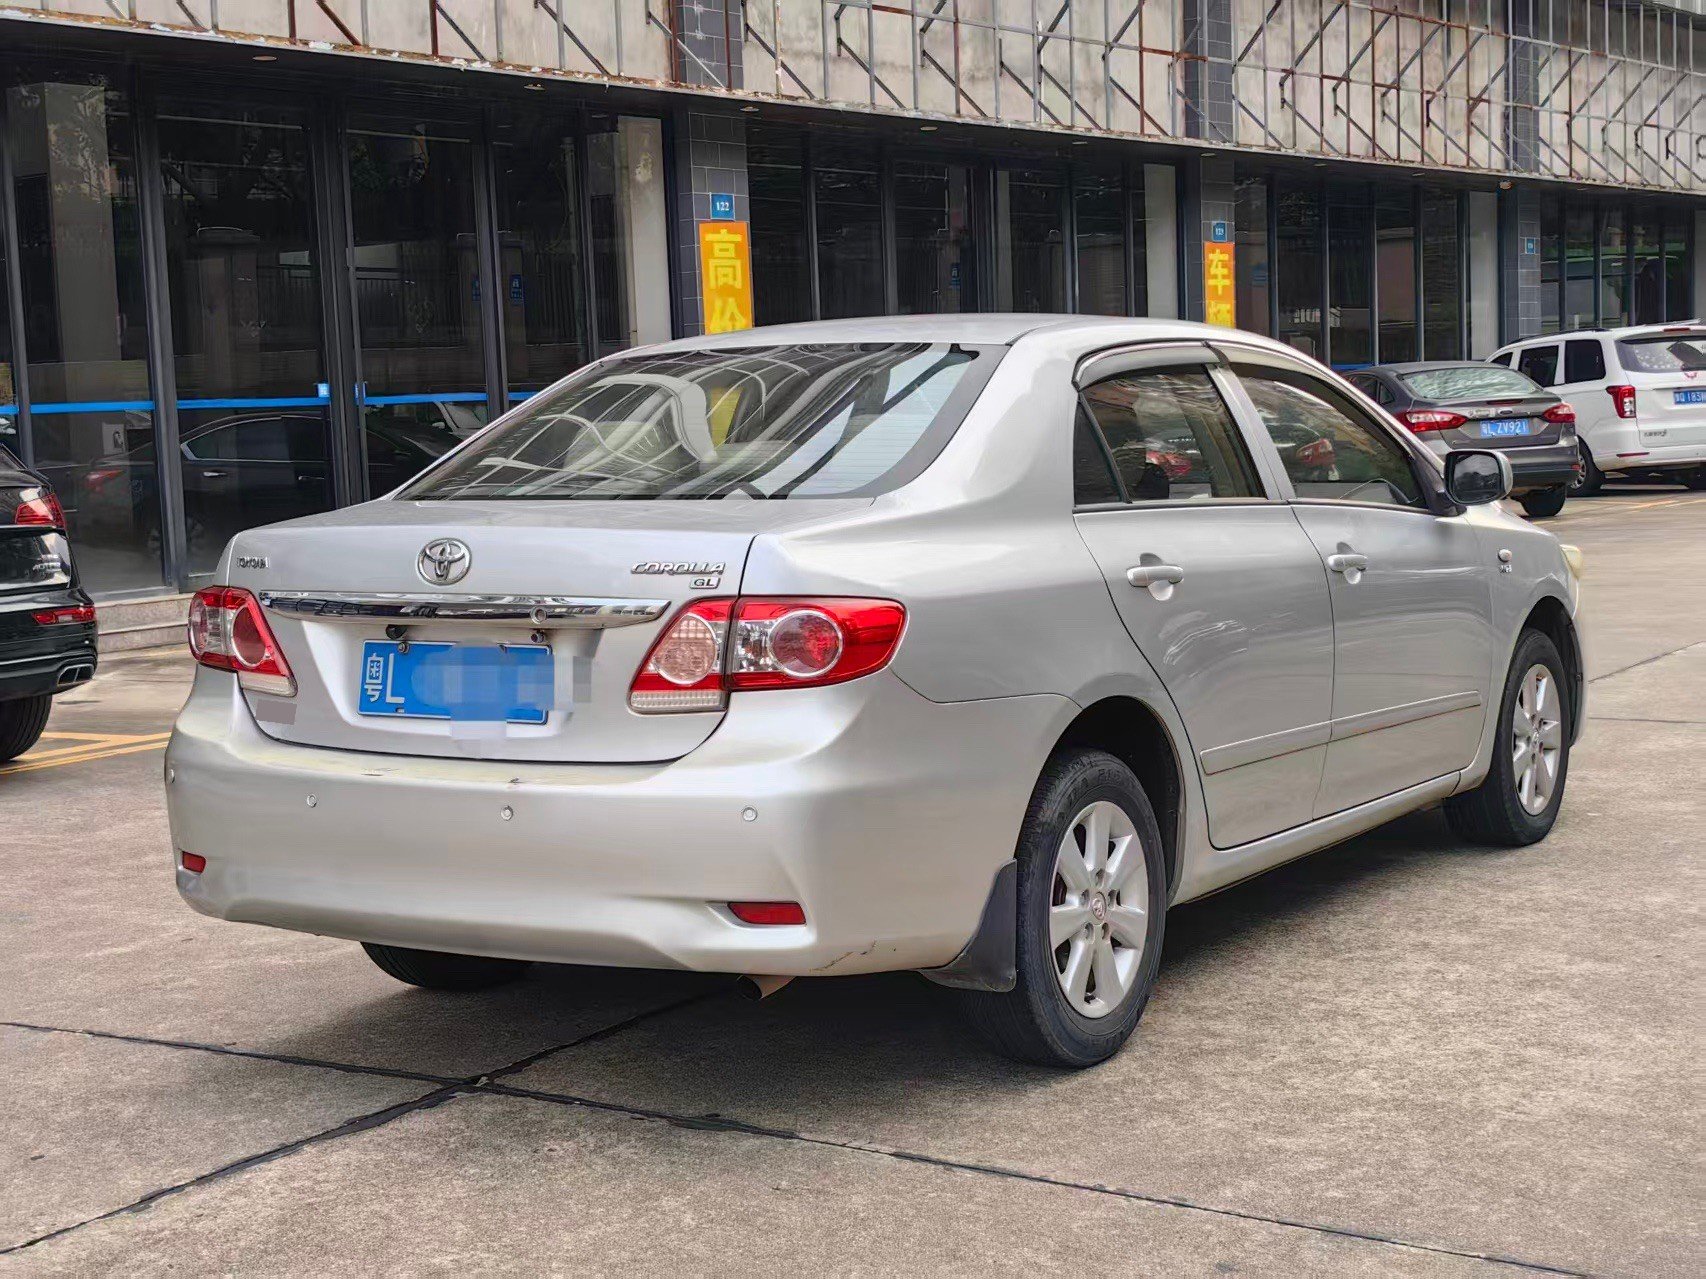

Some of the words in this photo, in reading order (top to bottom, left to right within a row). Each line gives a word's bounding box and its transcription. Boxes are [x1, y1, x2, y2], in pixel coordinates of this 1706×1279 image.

[716, 202, 730, 211] 122
[1496, 420, 1527, 434] ZV921
[631, 562, 726, 575] COROLLA
